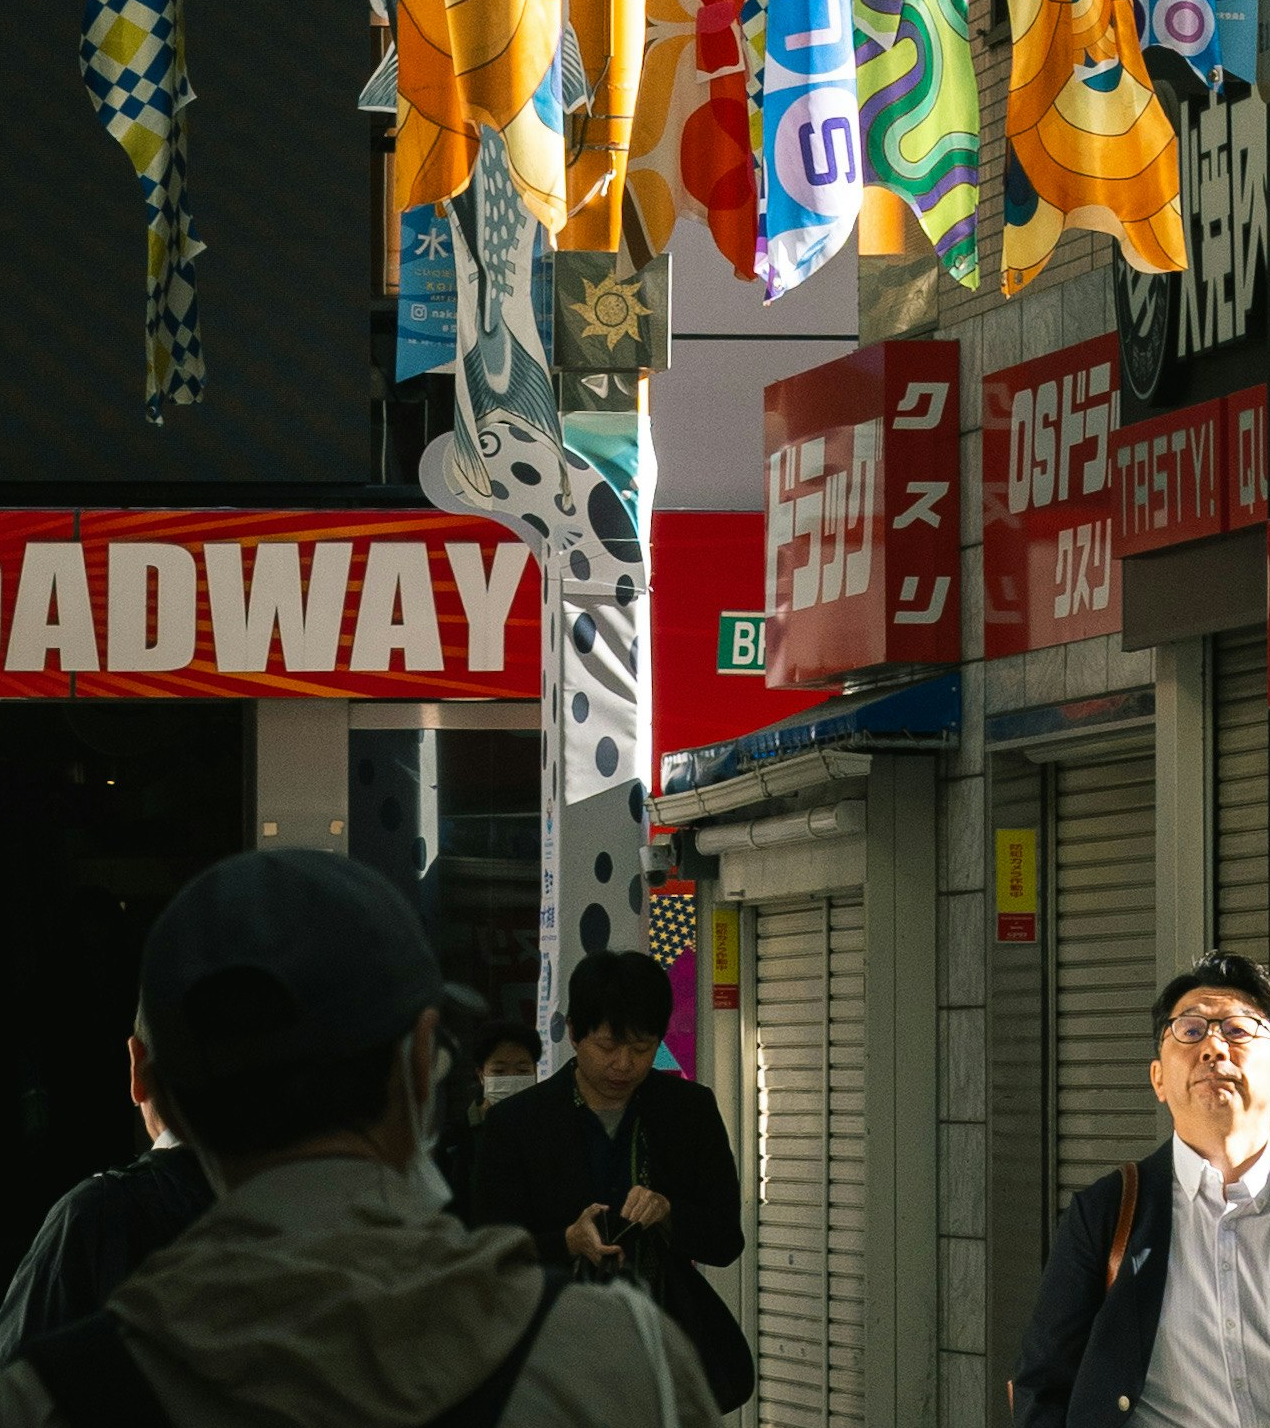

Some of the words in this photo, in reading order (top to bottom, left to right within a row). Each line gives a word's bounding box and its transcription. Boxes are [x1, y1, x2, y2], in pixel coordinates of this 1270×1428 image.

[765, 416, 884, 619] ドラッグ
[891, 381, 952, 625] クスリ
[1117, 420, 1216, 538] TASTY!
[1053, 518, 1113, 619] クスリ
